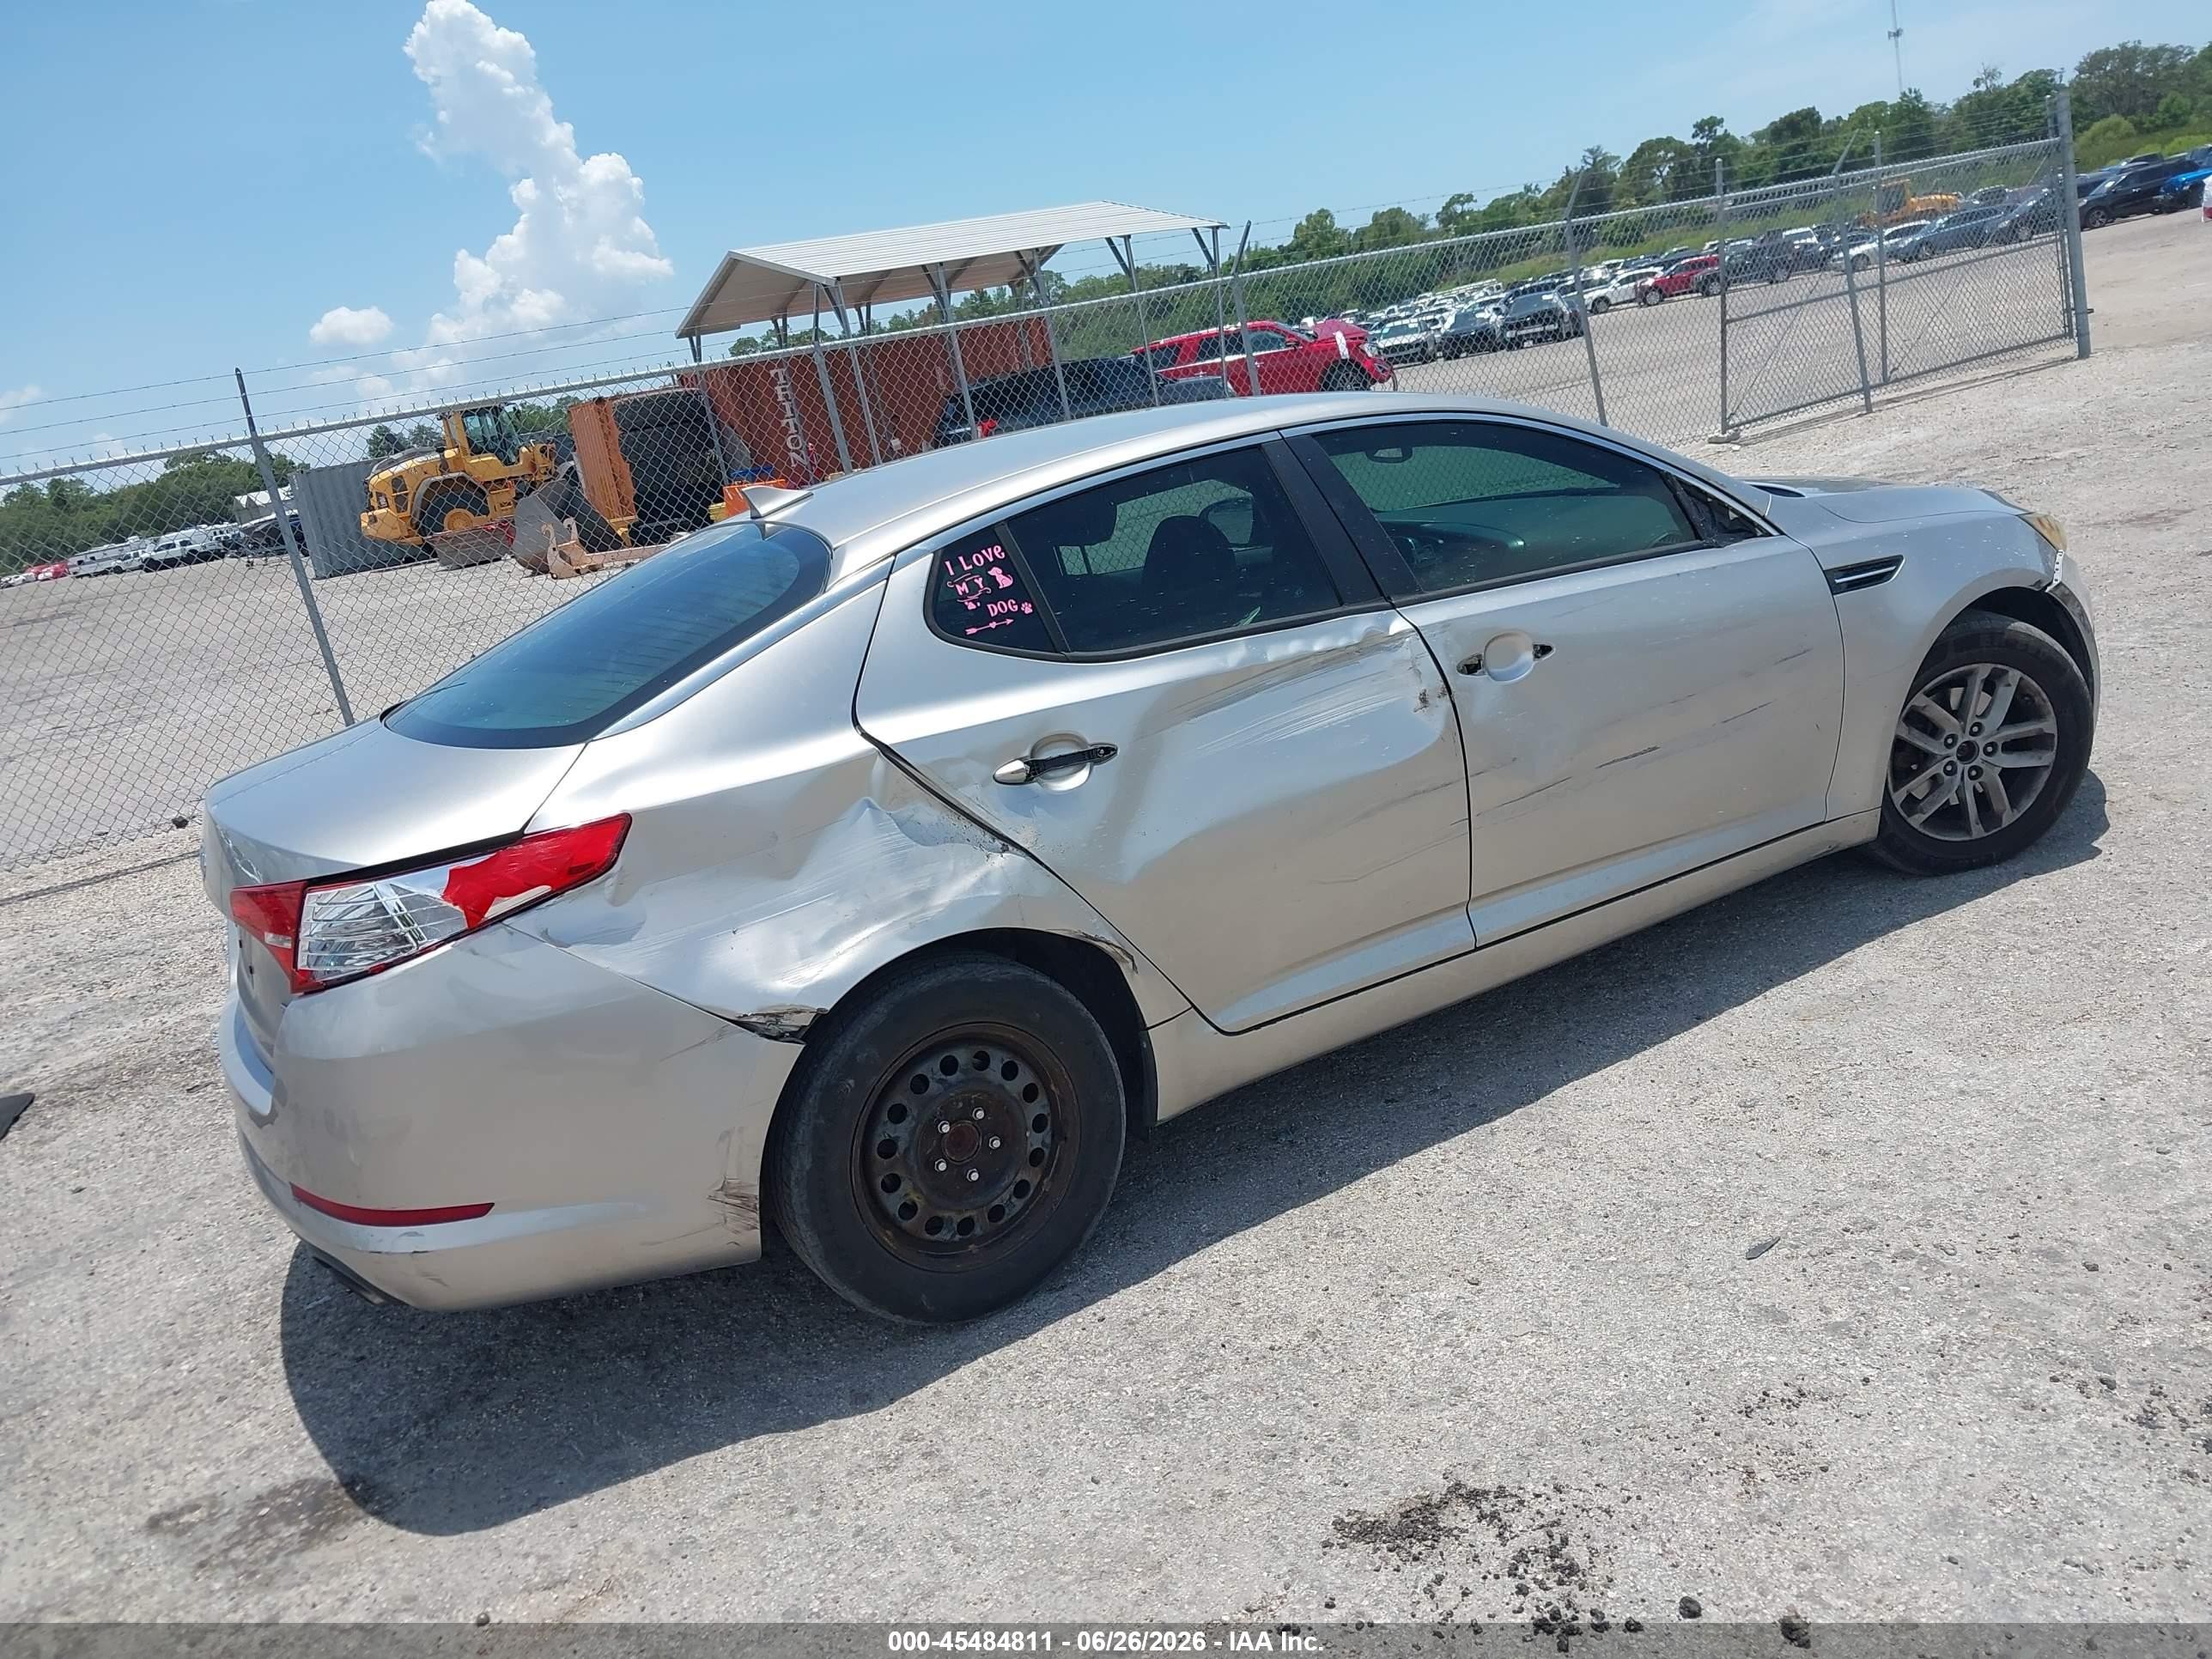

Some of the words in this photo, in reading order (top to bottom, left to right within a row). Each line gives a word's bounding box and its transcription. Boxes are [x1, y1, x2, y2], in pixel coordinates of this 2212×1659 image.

[945, 560, 955, 575] I
[955, 577, 984, 596] MY
[987, 599, 1018, 617] DOG
